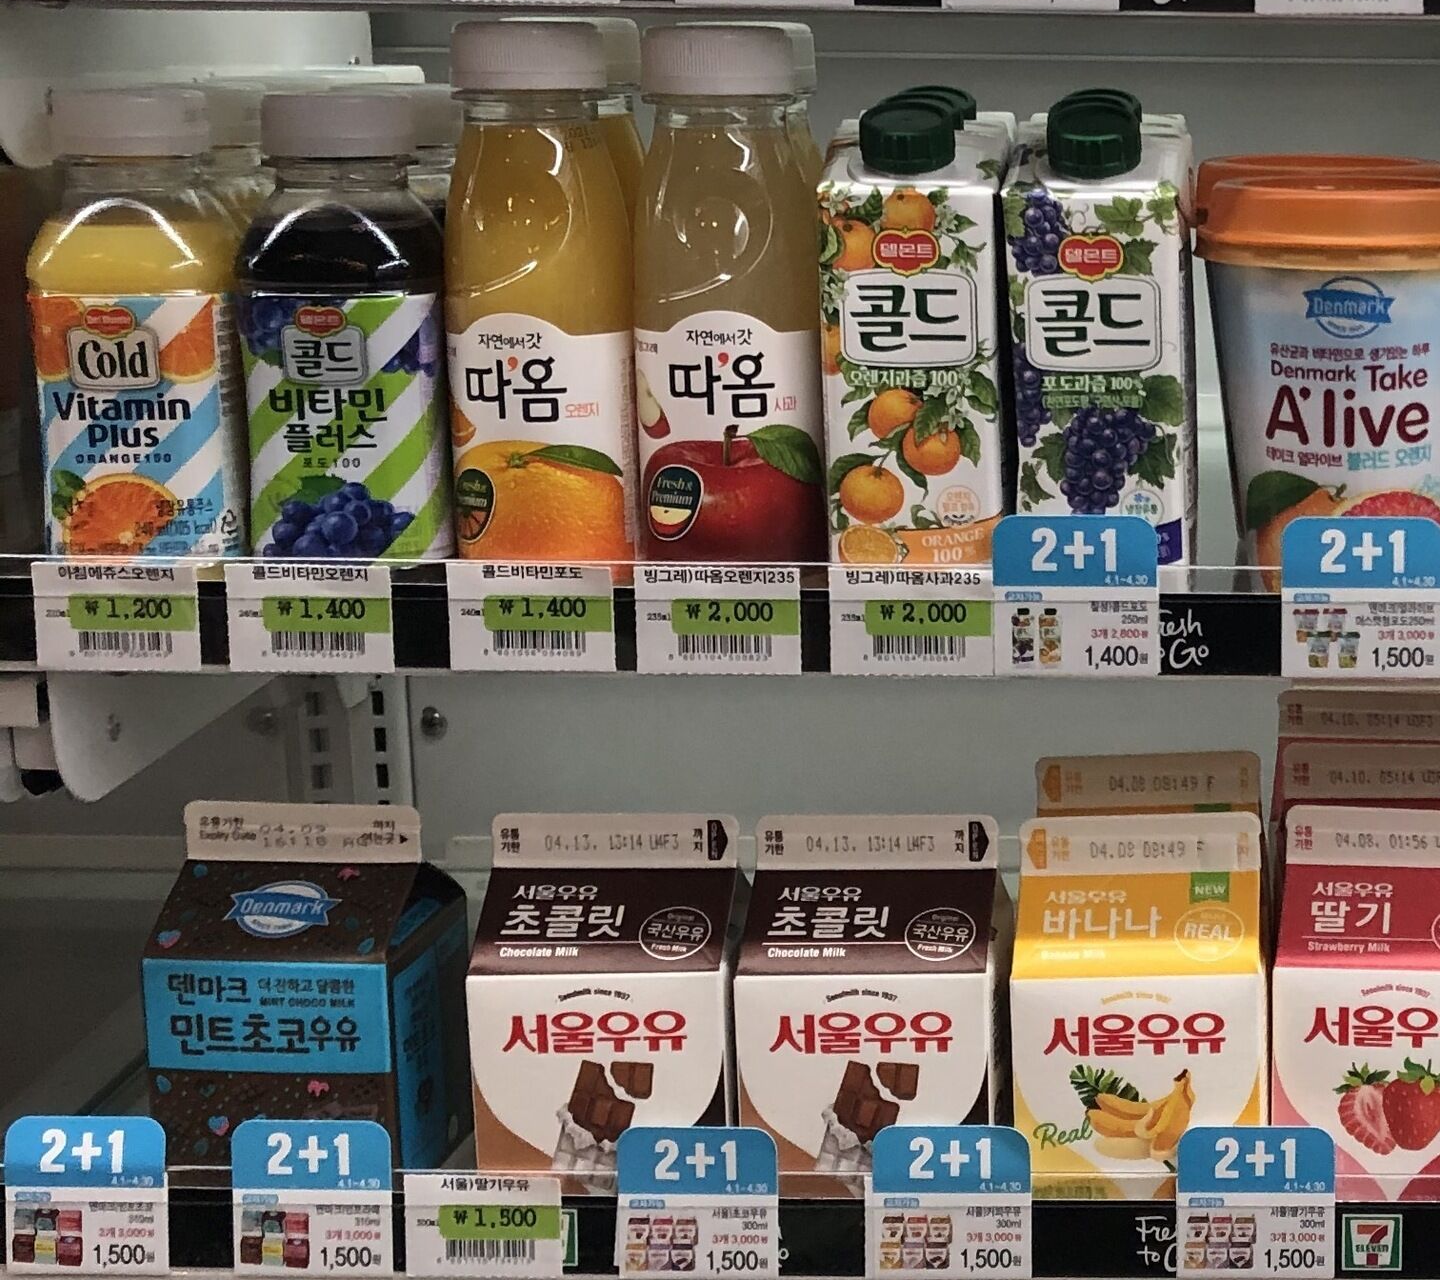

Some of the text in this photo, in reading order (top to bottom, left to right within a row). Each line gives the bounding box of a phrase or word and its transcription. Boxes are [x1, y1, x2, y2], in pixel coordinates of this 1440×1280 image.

[879, 243, 935, 260] 델몬트
[849, 284, 967, 354] 콜드
[478, 333, 543, 350] 자연에서 갓
[77, 340, 149, 380] Cold
[290, 340, 360, 378] 콜드
[848, 369, 971, 388] 오렌지과즙 100%
[1270, 360, 1429, 392] Denmark Take
[53, 392, 191, 421] Vitamin
[269, 389, 388, 422] 비타민
[88, 424, 160, 448] Plus
[282, 424, 378, 453] 플러스
[1320, 530, 1406, 574] 2+1
[482, 565, 583, 580] 콜드비타민포도
[644, 568, 795, 585] 빙그레)따옴오렌지235
[108, 598, 172, 620] 1,200
[1085, 645, 1149, 668] 1,400원
[1372, 646, 1434, 669] 1,500원
[513, 885, 598, 901] 서울우유
[1194, 884, 1226, 896] NEW
[241, 898, 325, 916] Denmark
[1310, 900, 1391, 935] 딸기
[500, 903, 626, 938] 초콜릿
[646, 922, 705, 941] 국산우유
[1042, 906, 1162, 942] 바나나
[1183, 922, 1234, 942] REAL
[500, 946, 579, 959] Chocolate Milk
[1307, 941, 1391, 955] Strawberry Milk
[168, 974, 251, 1005] 덴마크
[169, 1015, 360, 1056] 민트초코우유
[502, 1010, 688, 1054] 서울우유
[40, 1130, 126, 1173] 2+1
[654, 1139, 738, 1181] 2+1
[440, 1177, 530, 1192] 서울)딸기우유
[706, 1250, 769, 1272] 1,500원
